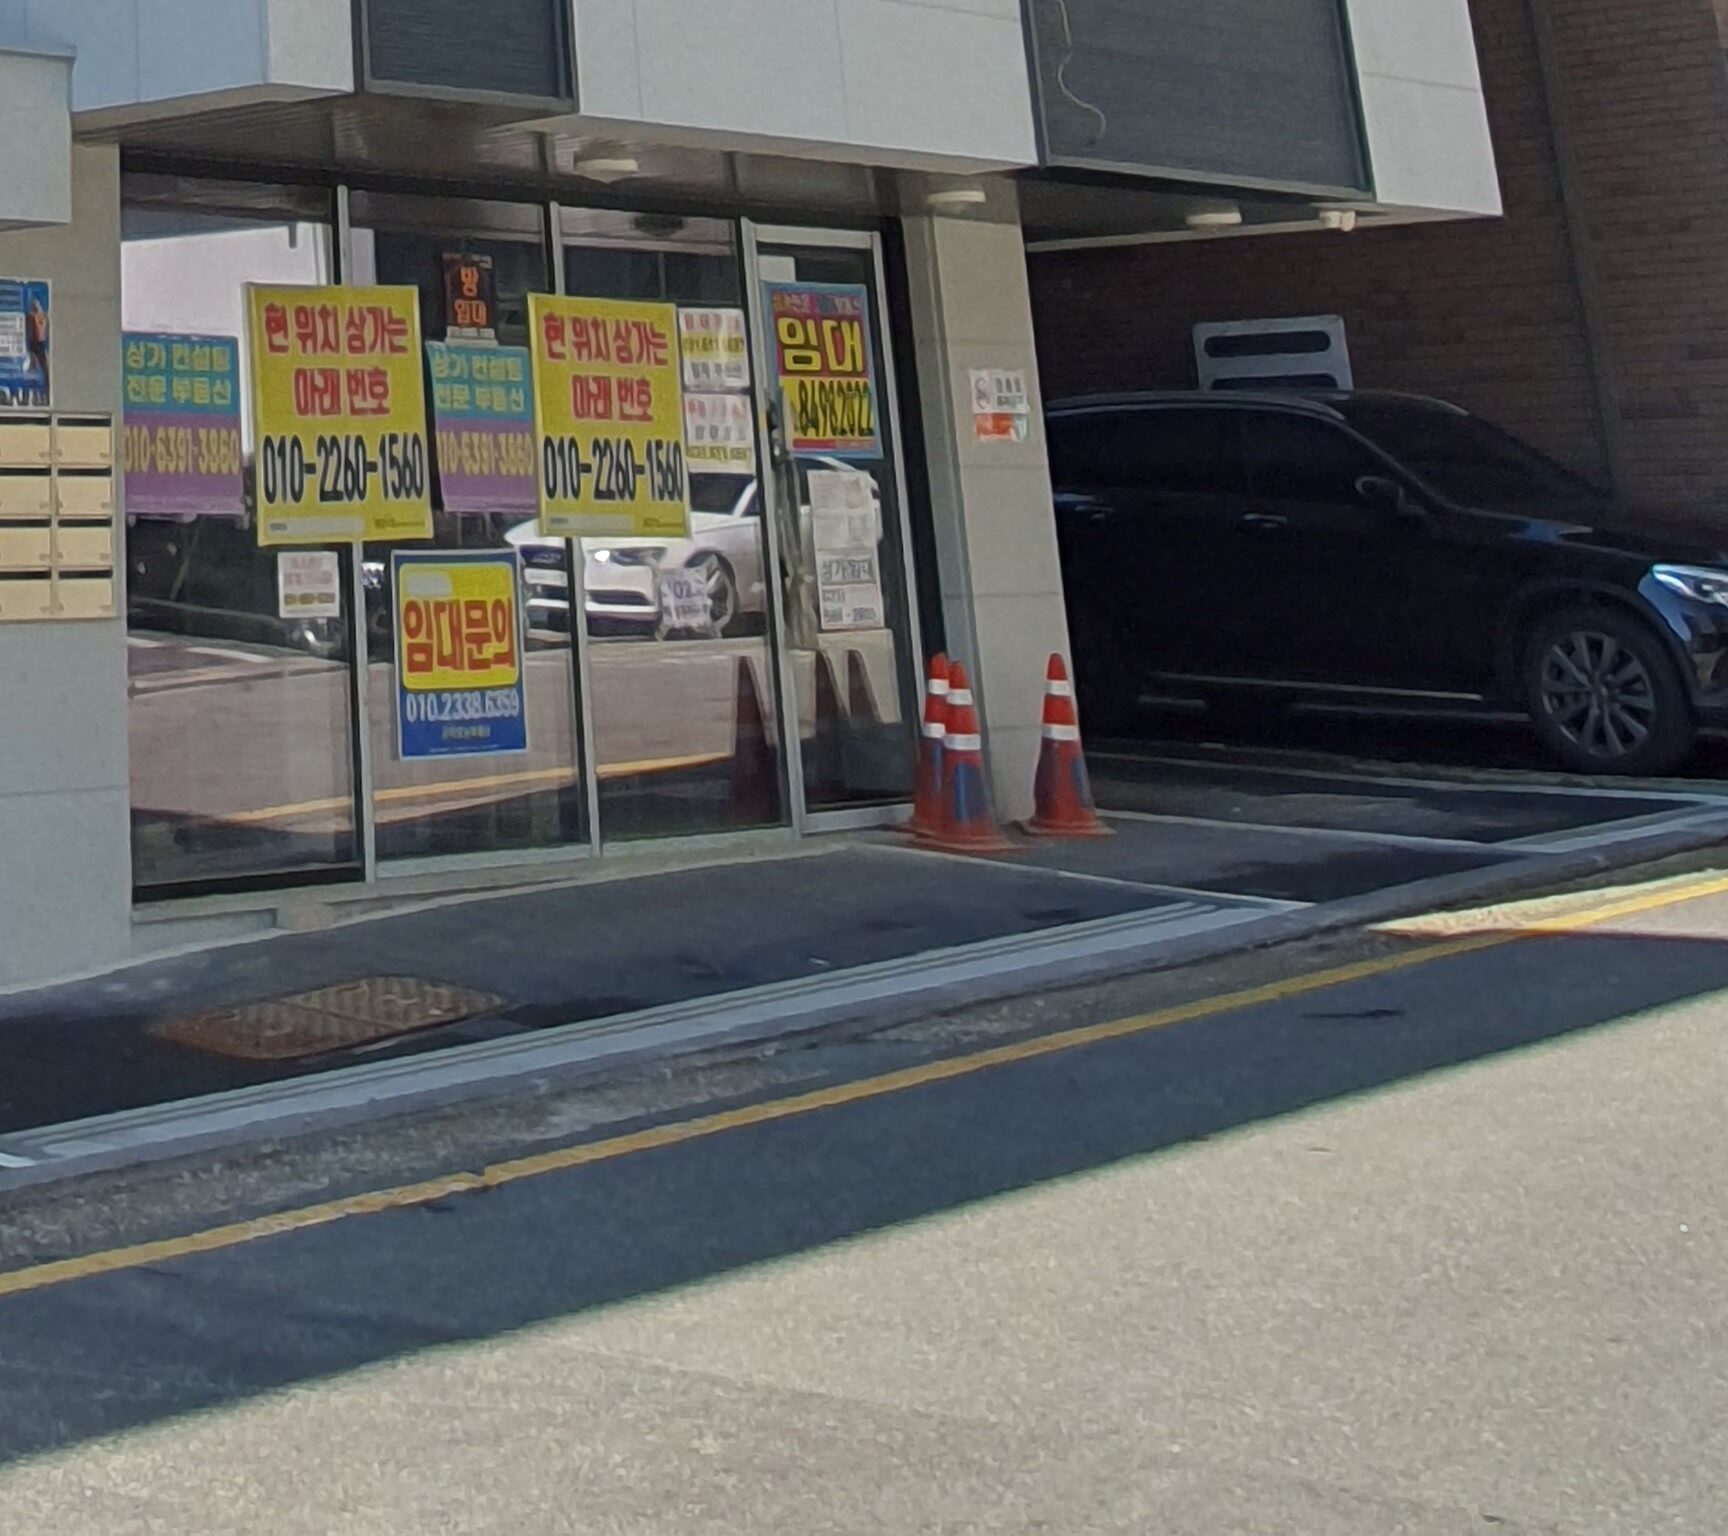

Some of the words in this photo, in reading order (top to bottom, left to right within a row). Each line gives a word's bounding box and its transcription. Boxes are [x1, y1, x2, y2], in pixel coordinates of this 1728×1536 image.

[460, 266, 480, 296] 방
[264, 303, 289, 353] 현
[294, 305, 340, 354] 위치
[346, 306, 408, 354] 상가는
[455, 300, 487, 326] 임대
[543, 312, 566, 360] 현
[571, 316, 611, 362] 위치
[613, 319, 669, 365] 상가는
[127, 341, 167, 370] 상가
[777, 316, 864, 372] 임대
[294, 368, 341, 416] 아래
[345, 367, 390, 416] 번호
[572, 374, 612, 420] 아래
[617, 375, 653, 421] 번호
[263, 432, 424, 504] 010-2260-1560
[543, 435, 684, 502] 010-2260-1560
[403, 597, 515, 673] 임대문의
